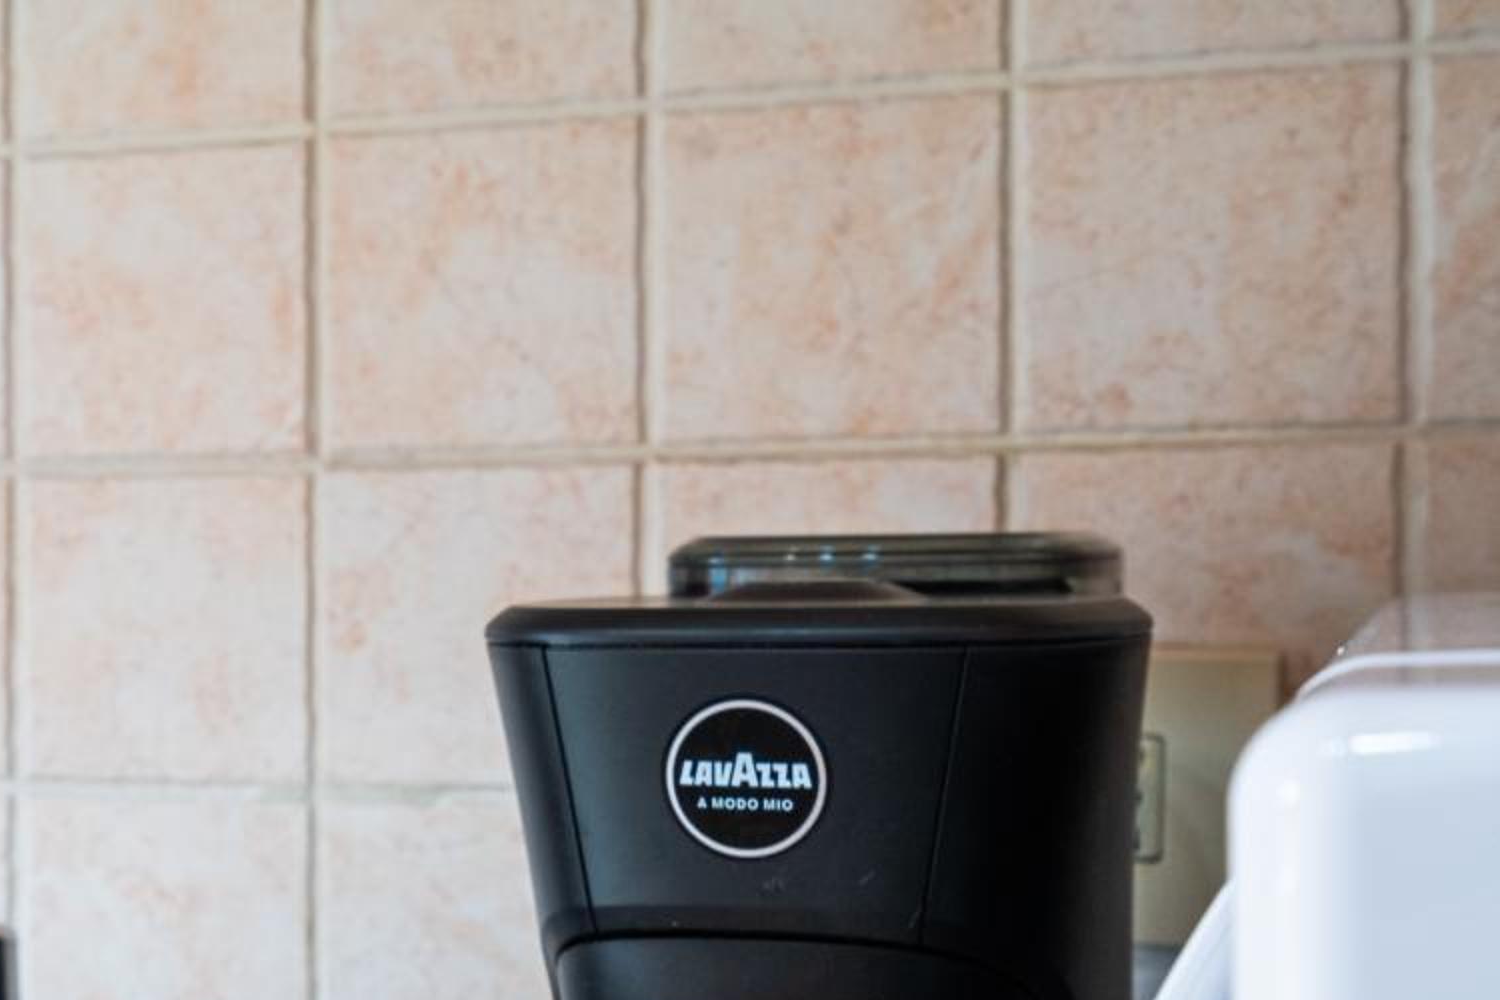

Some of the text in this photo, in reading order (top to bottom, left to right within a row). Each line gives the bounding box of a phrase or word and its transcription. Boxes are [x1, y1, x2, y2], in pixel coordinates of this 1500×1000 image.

[679, 751, 813, 789] LAVAZZA
[697, 797, 793, 812] A MODO MIO
